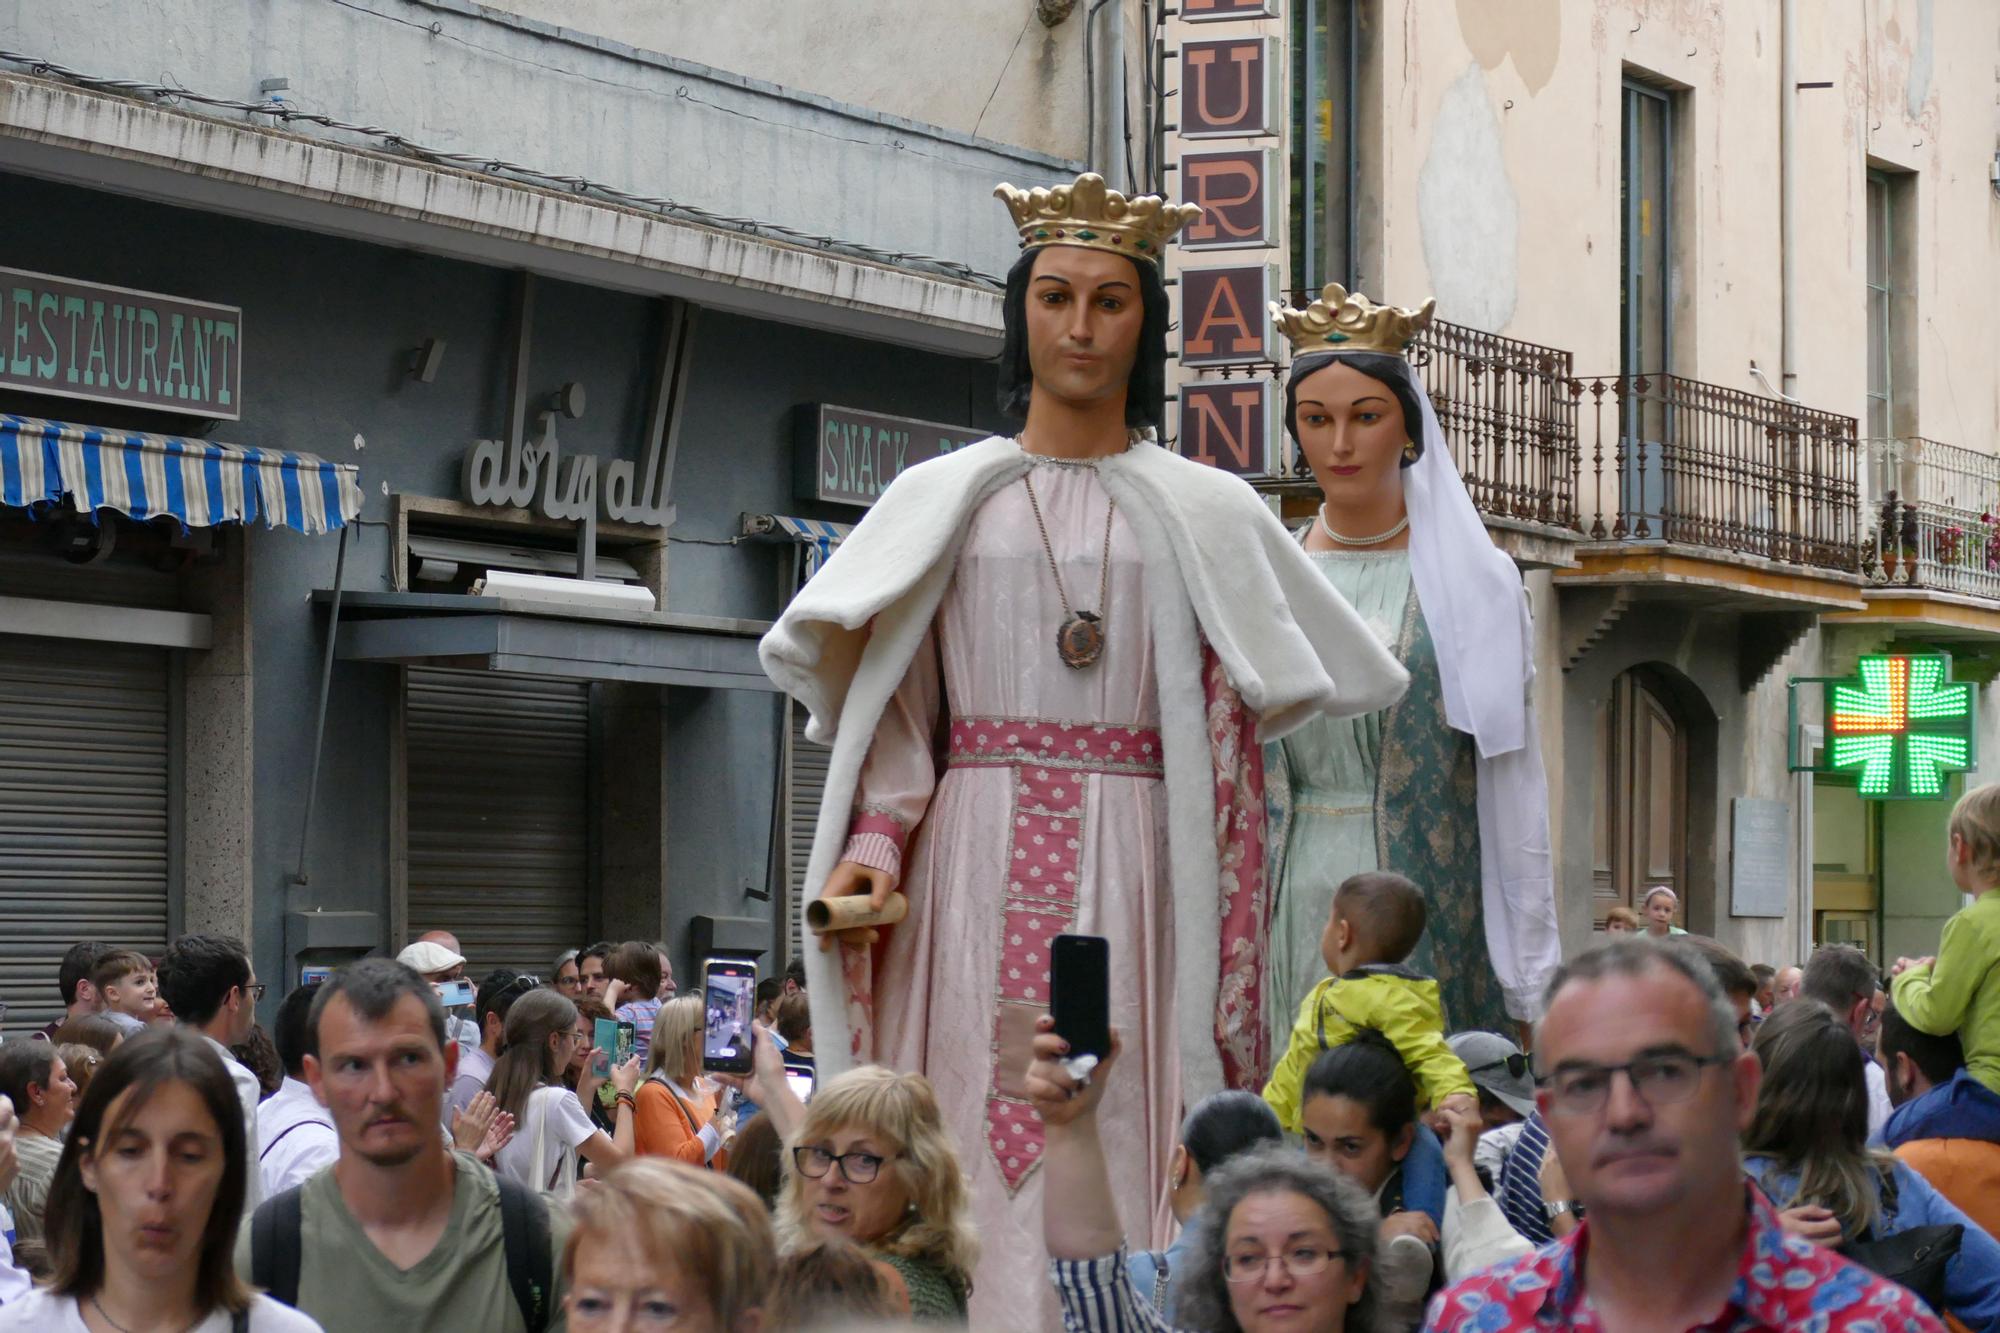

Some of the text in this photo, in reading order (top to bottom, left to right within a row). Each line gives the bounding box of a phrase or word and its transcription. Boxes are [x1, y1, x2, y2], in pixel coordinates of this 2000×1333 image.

[1185, 0, 1261, 468] URAN
[0, 287, 236, 405] ESTAURANT
[825, 419, 909, 496] SNACK
